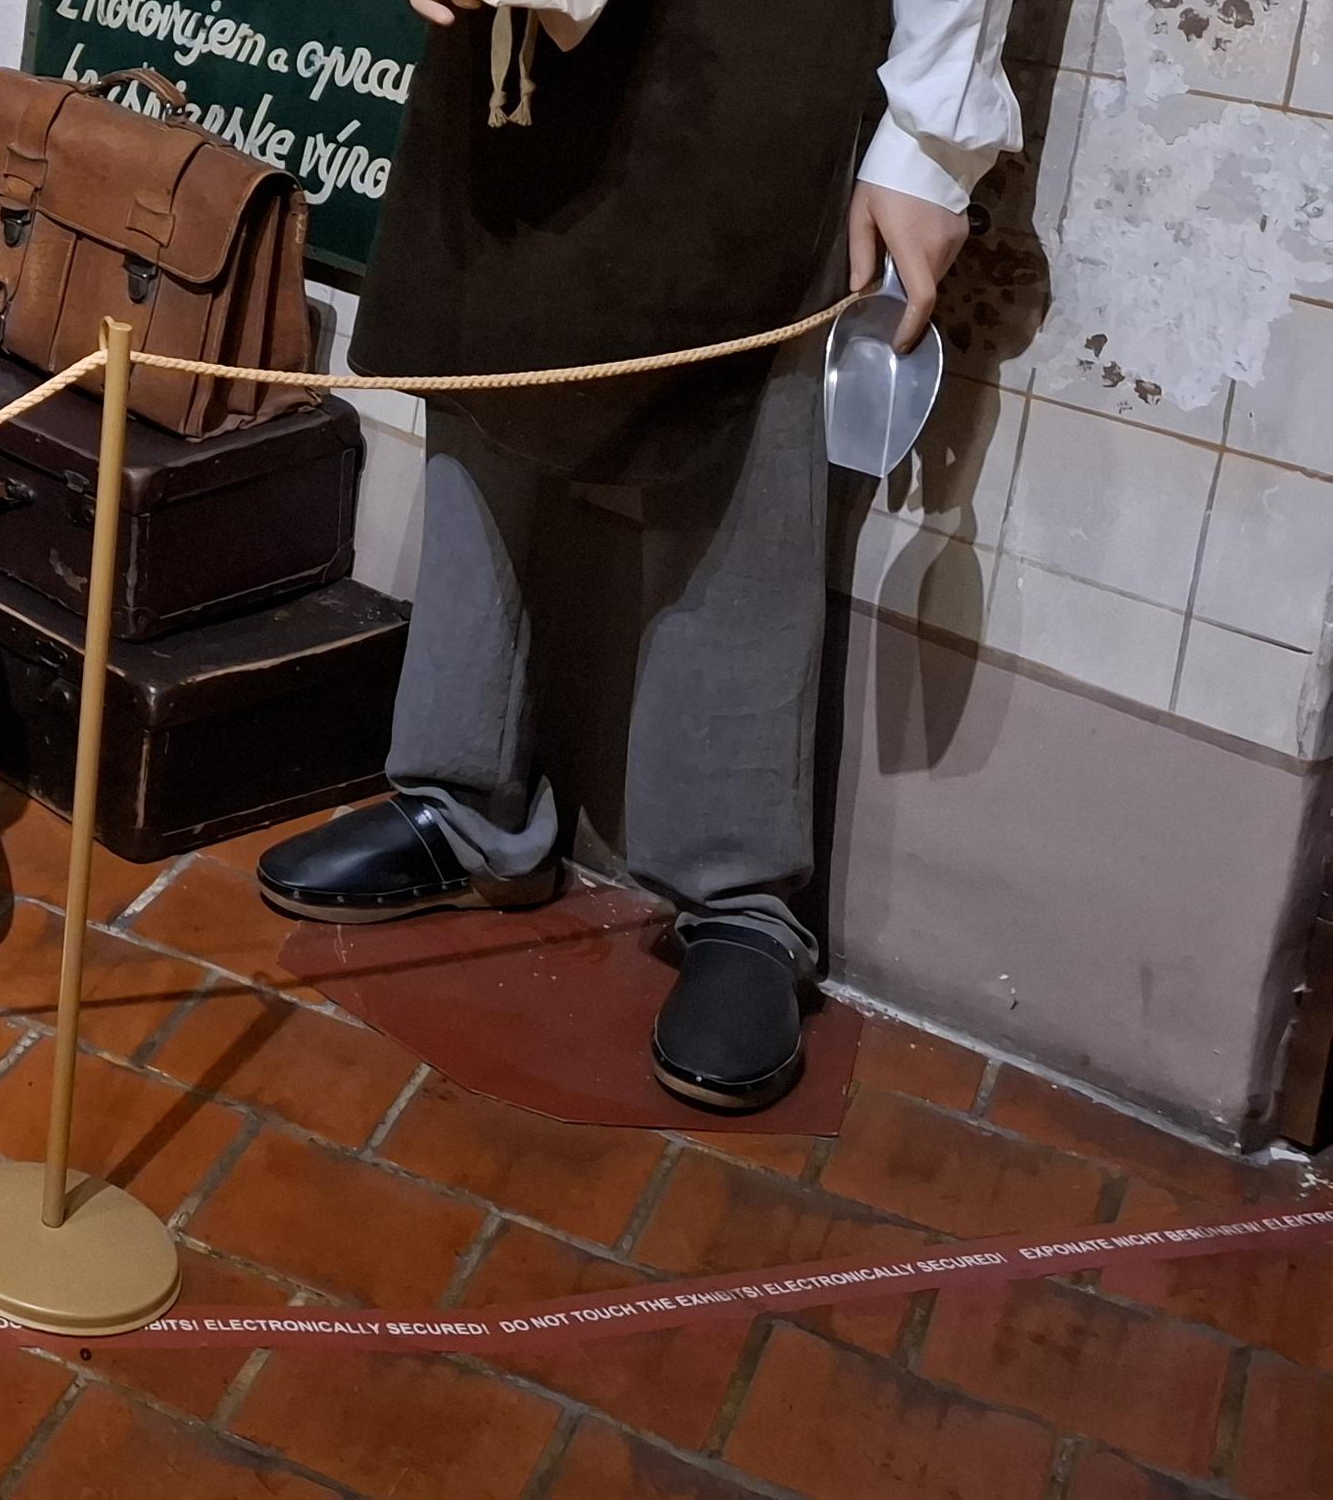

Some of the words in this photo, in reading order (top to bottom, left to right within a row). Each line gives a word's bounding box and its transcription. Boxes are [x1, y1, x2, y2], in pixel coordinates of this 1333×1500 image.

[267, 47, 289, 73] a
[1019, 1238, 1114, 1260] EXPONATE
[1109, 1231, 1165, 1249] NICHT
[499, 1319, 530, 1334] DO
[530, 1312, 573, 1329] NOT
[570, 1304, 637, 1323] TOUCH
[635, 1297, 677, 1314] THE
[675, 1284, 765, 1307] EXHIBITS!
[763, 1263, 916, 1296] ELECTRONICALLY
[916, 1252, 1008, 1274] SECURED!
[203, 1319, 380, 1335] ELECTRONICALLY
[386, 1322, 490, 1336] SECURED!
